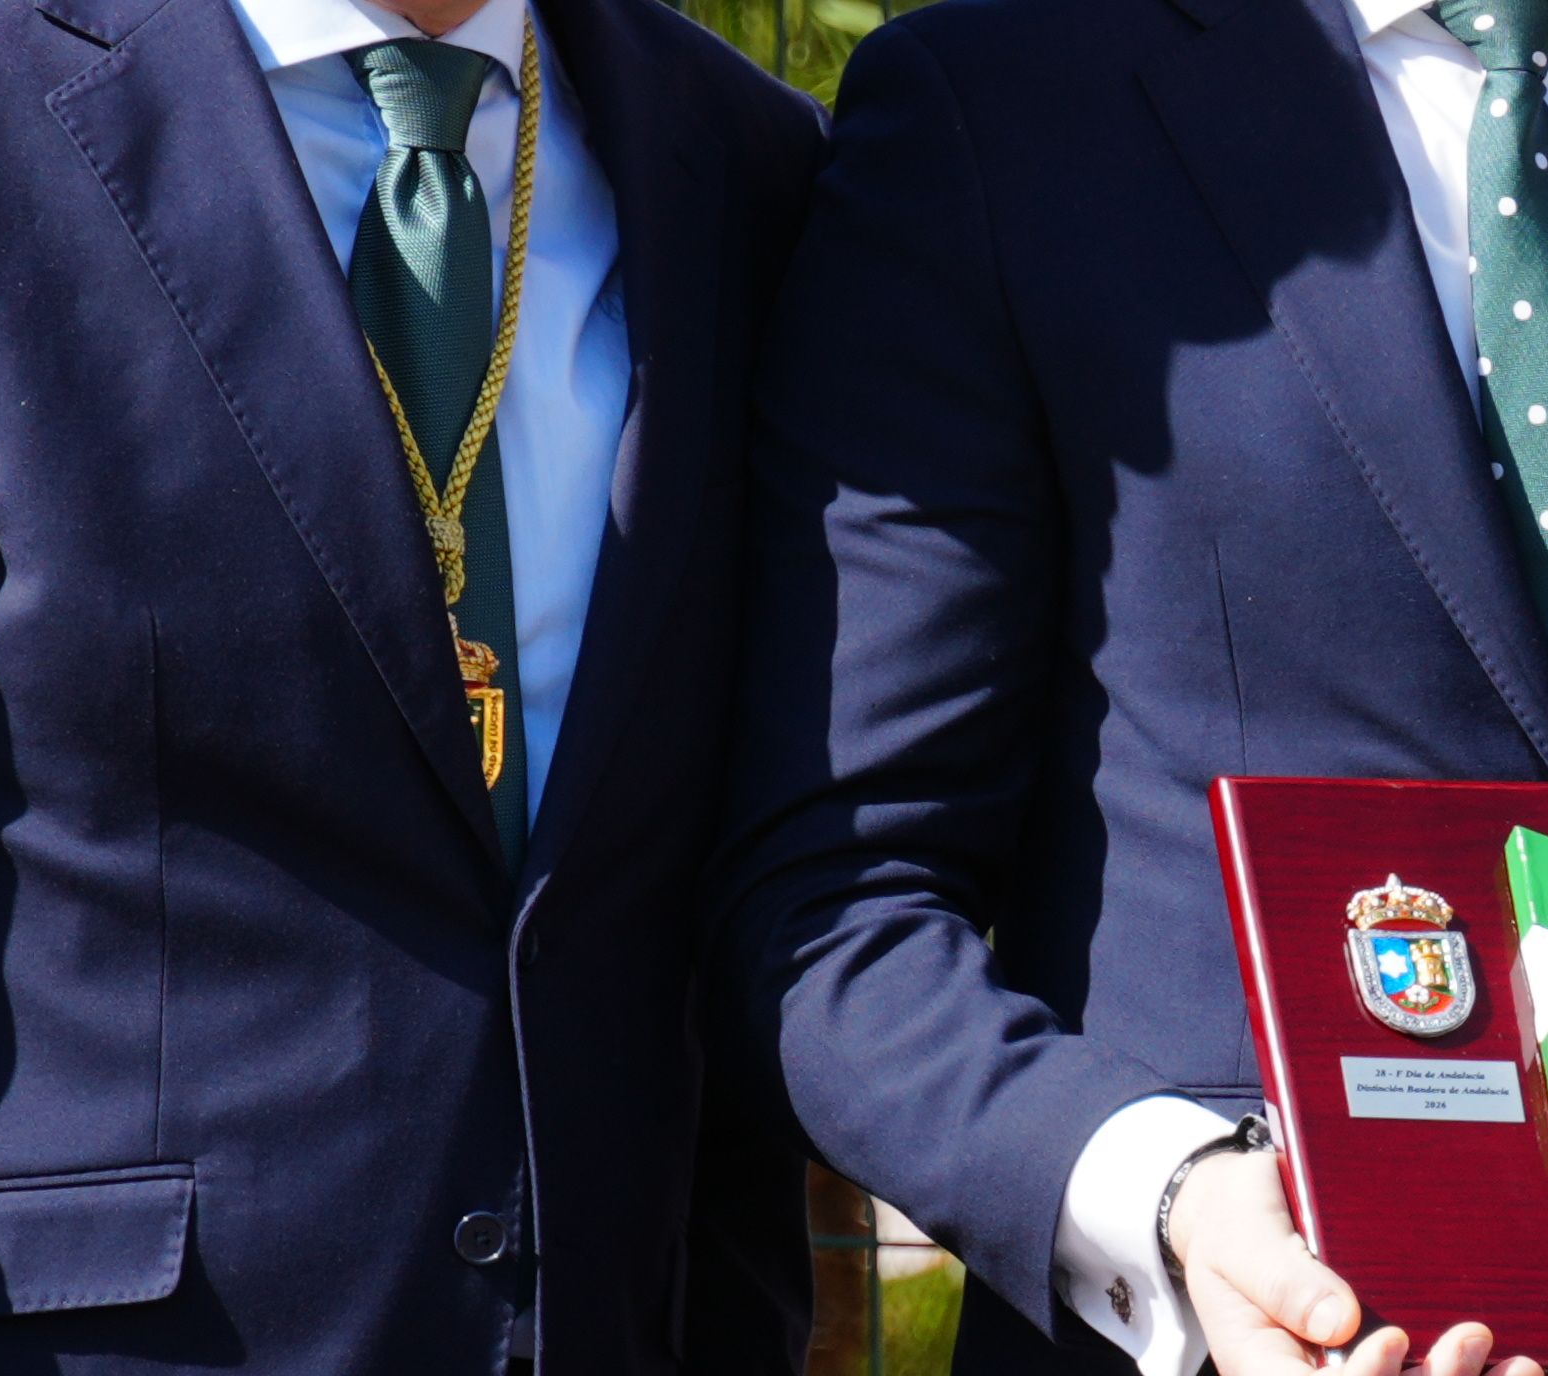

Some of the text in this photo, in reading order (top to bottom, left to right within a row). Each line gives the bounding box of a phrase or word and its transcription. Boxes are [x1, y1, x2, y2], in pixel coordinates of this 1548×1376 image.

[1375, 1069, 1386, 1077] 28
[1396, 1070, 1403, 1078] F
[1407, 1085, 1446, 1094] Bandera
[1449, 1086, 1459, 1094] de
[1425, 1100, 1446, 1109] 2026
